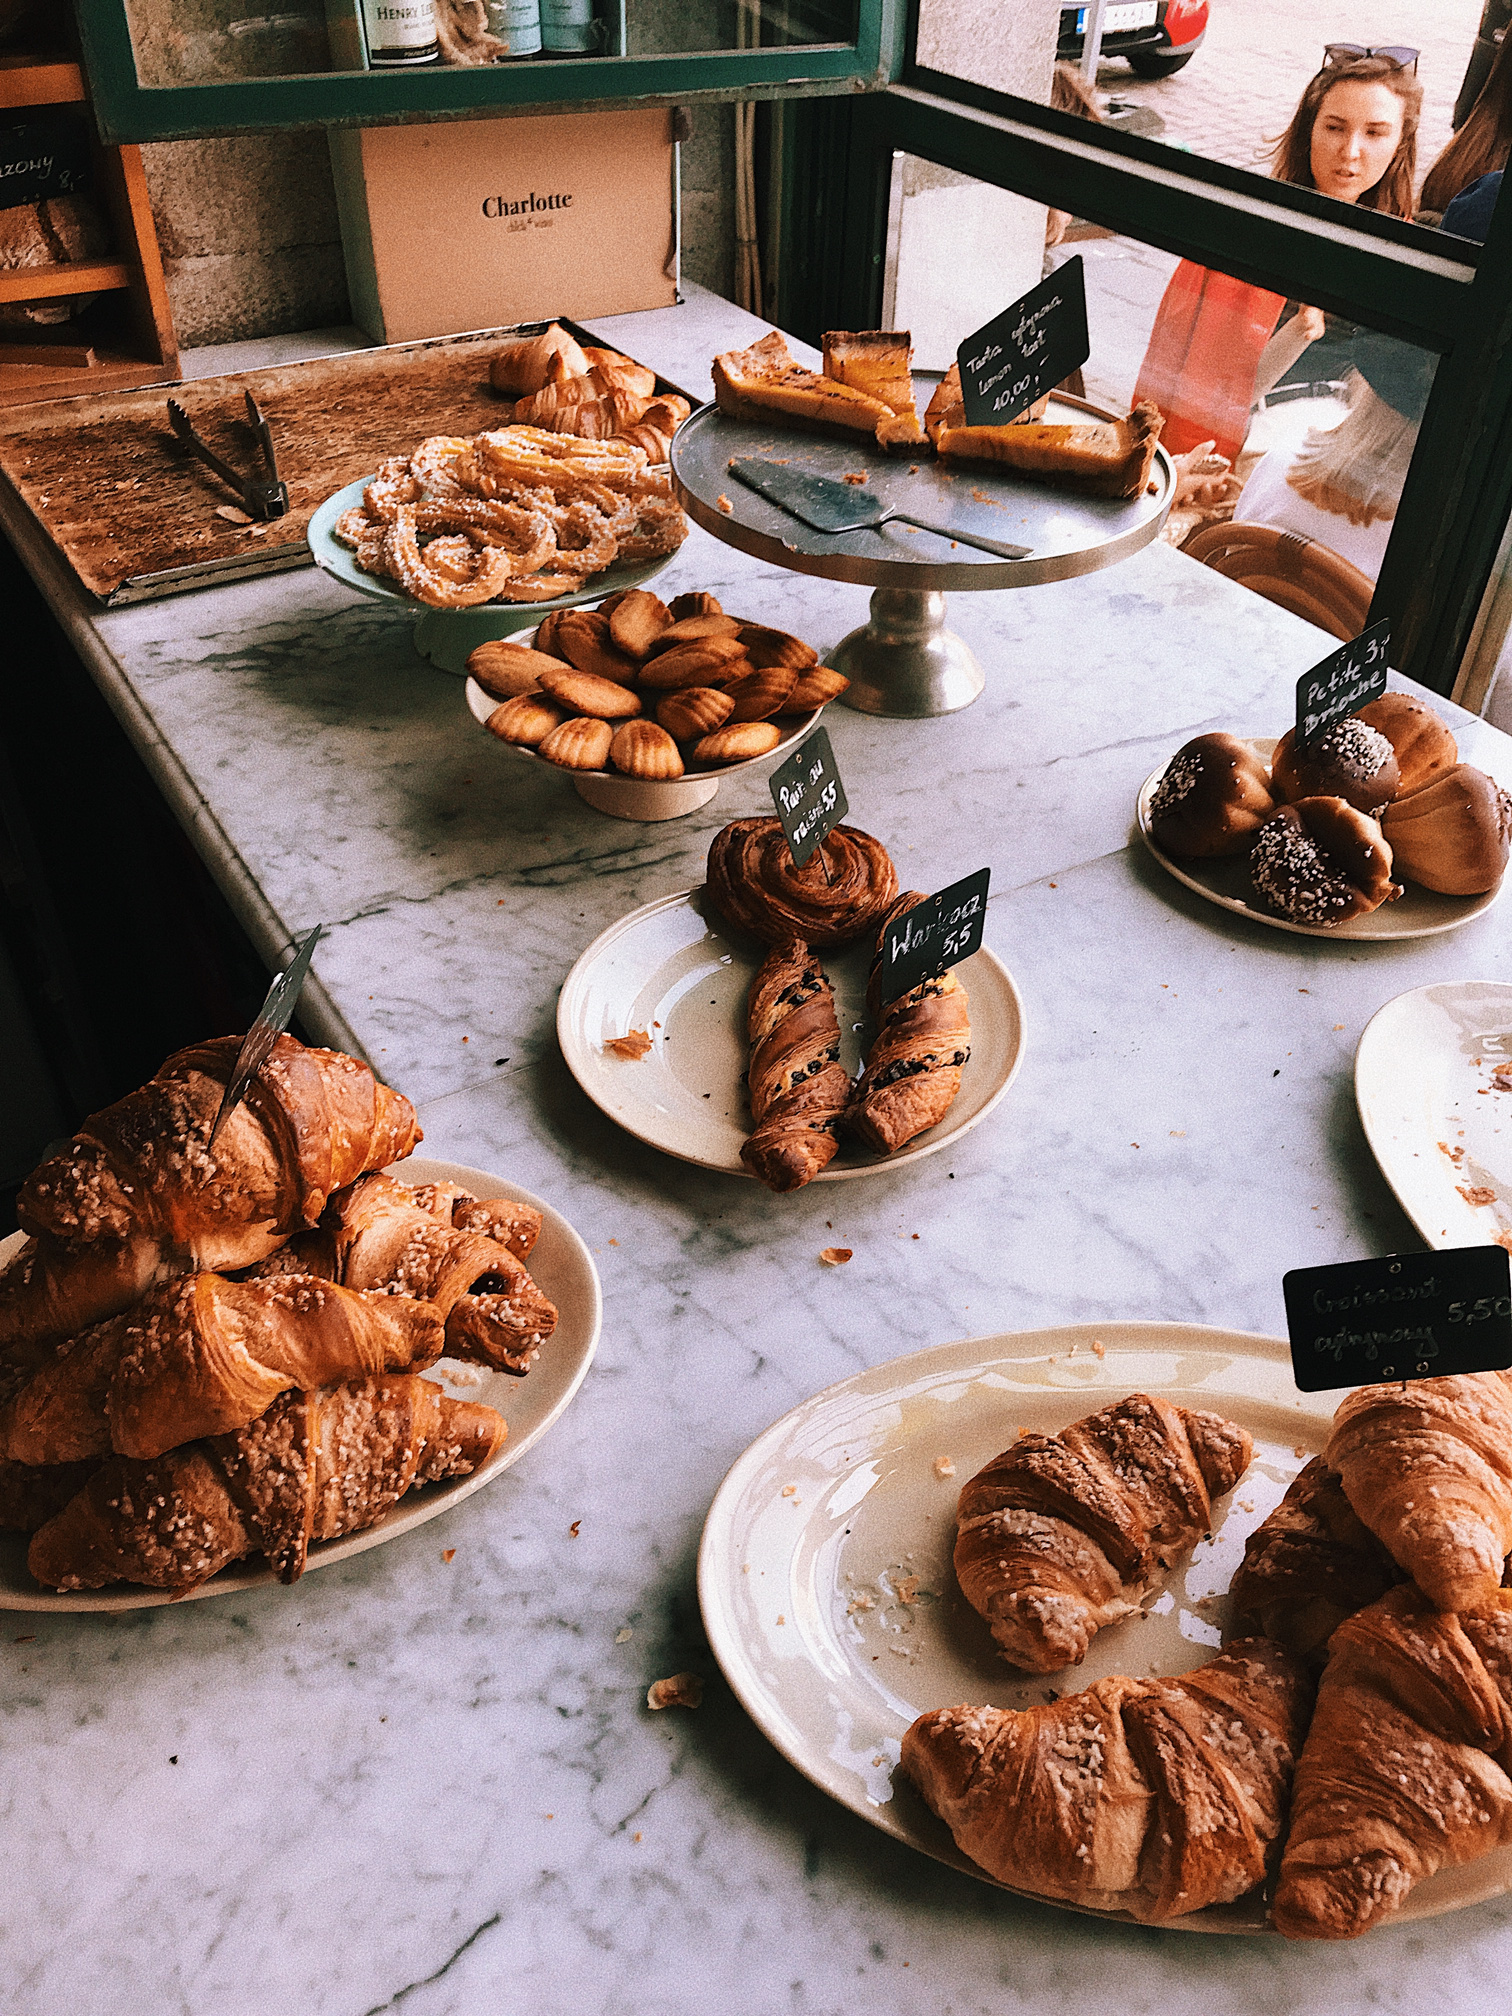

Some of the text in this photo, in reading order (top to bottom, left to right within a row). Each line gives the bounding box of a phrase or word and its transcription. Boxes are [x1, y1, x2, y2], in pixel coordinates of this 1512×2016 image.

[377, 6, 418, 21] HENRY
[482, 192, 574, 218] Charlotte
[966, 345, 1002, 374] Tarta
[978, 328, 1047, 396] Lemon tart
[1307, 658, 1362, 707] Petite
[1302, 670, 1385, 737] Brioche
[809, 759, 824, 786] au
[942, 922, 973, 957] 5,5
[1448, 1296, 1512, 1326] 5,50
